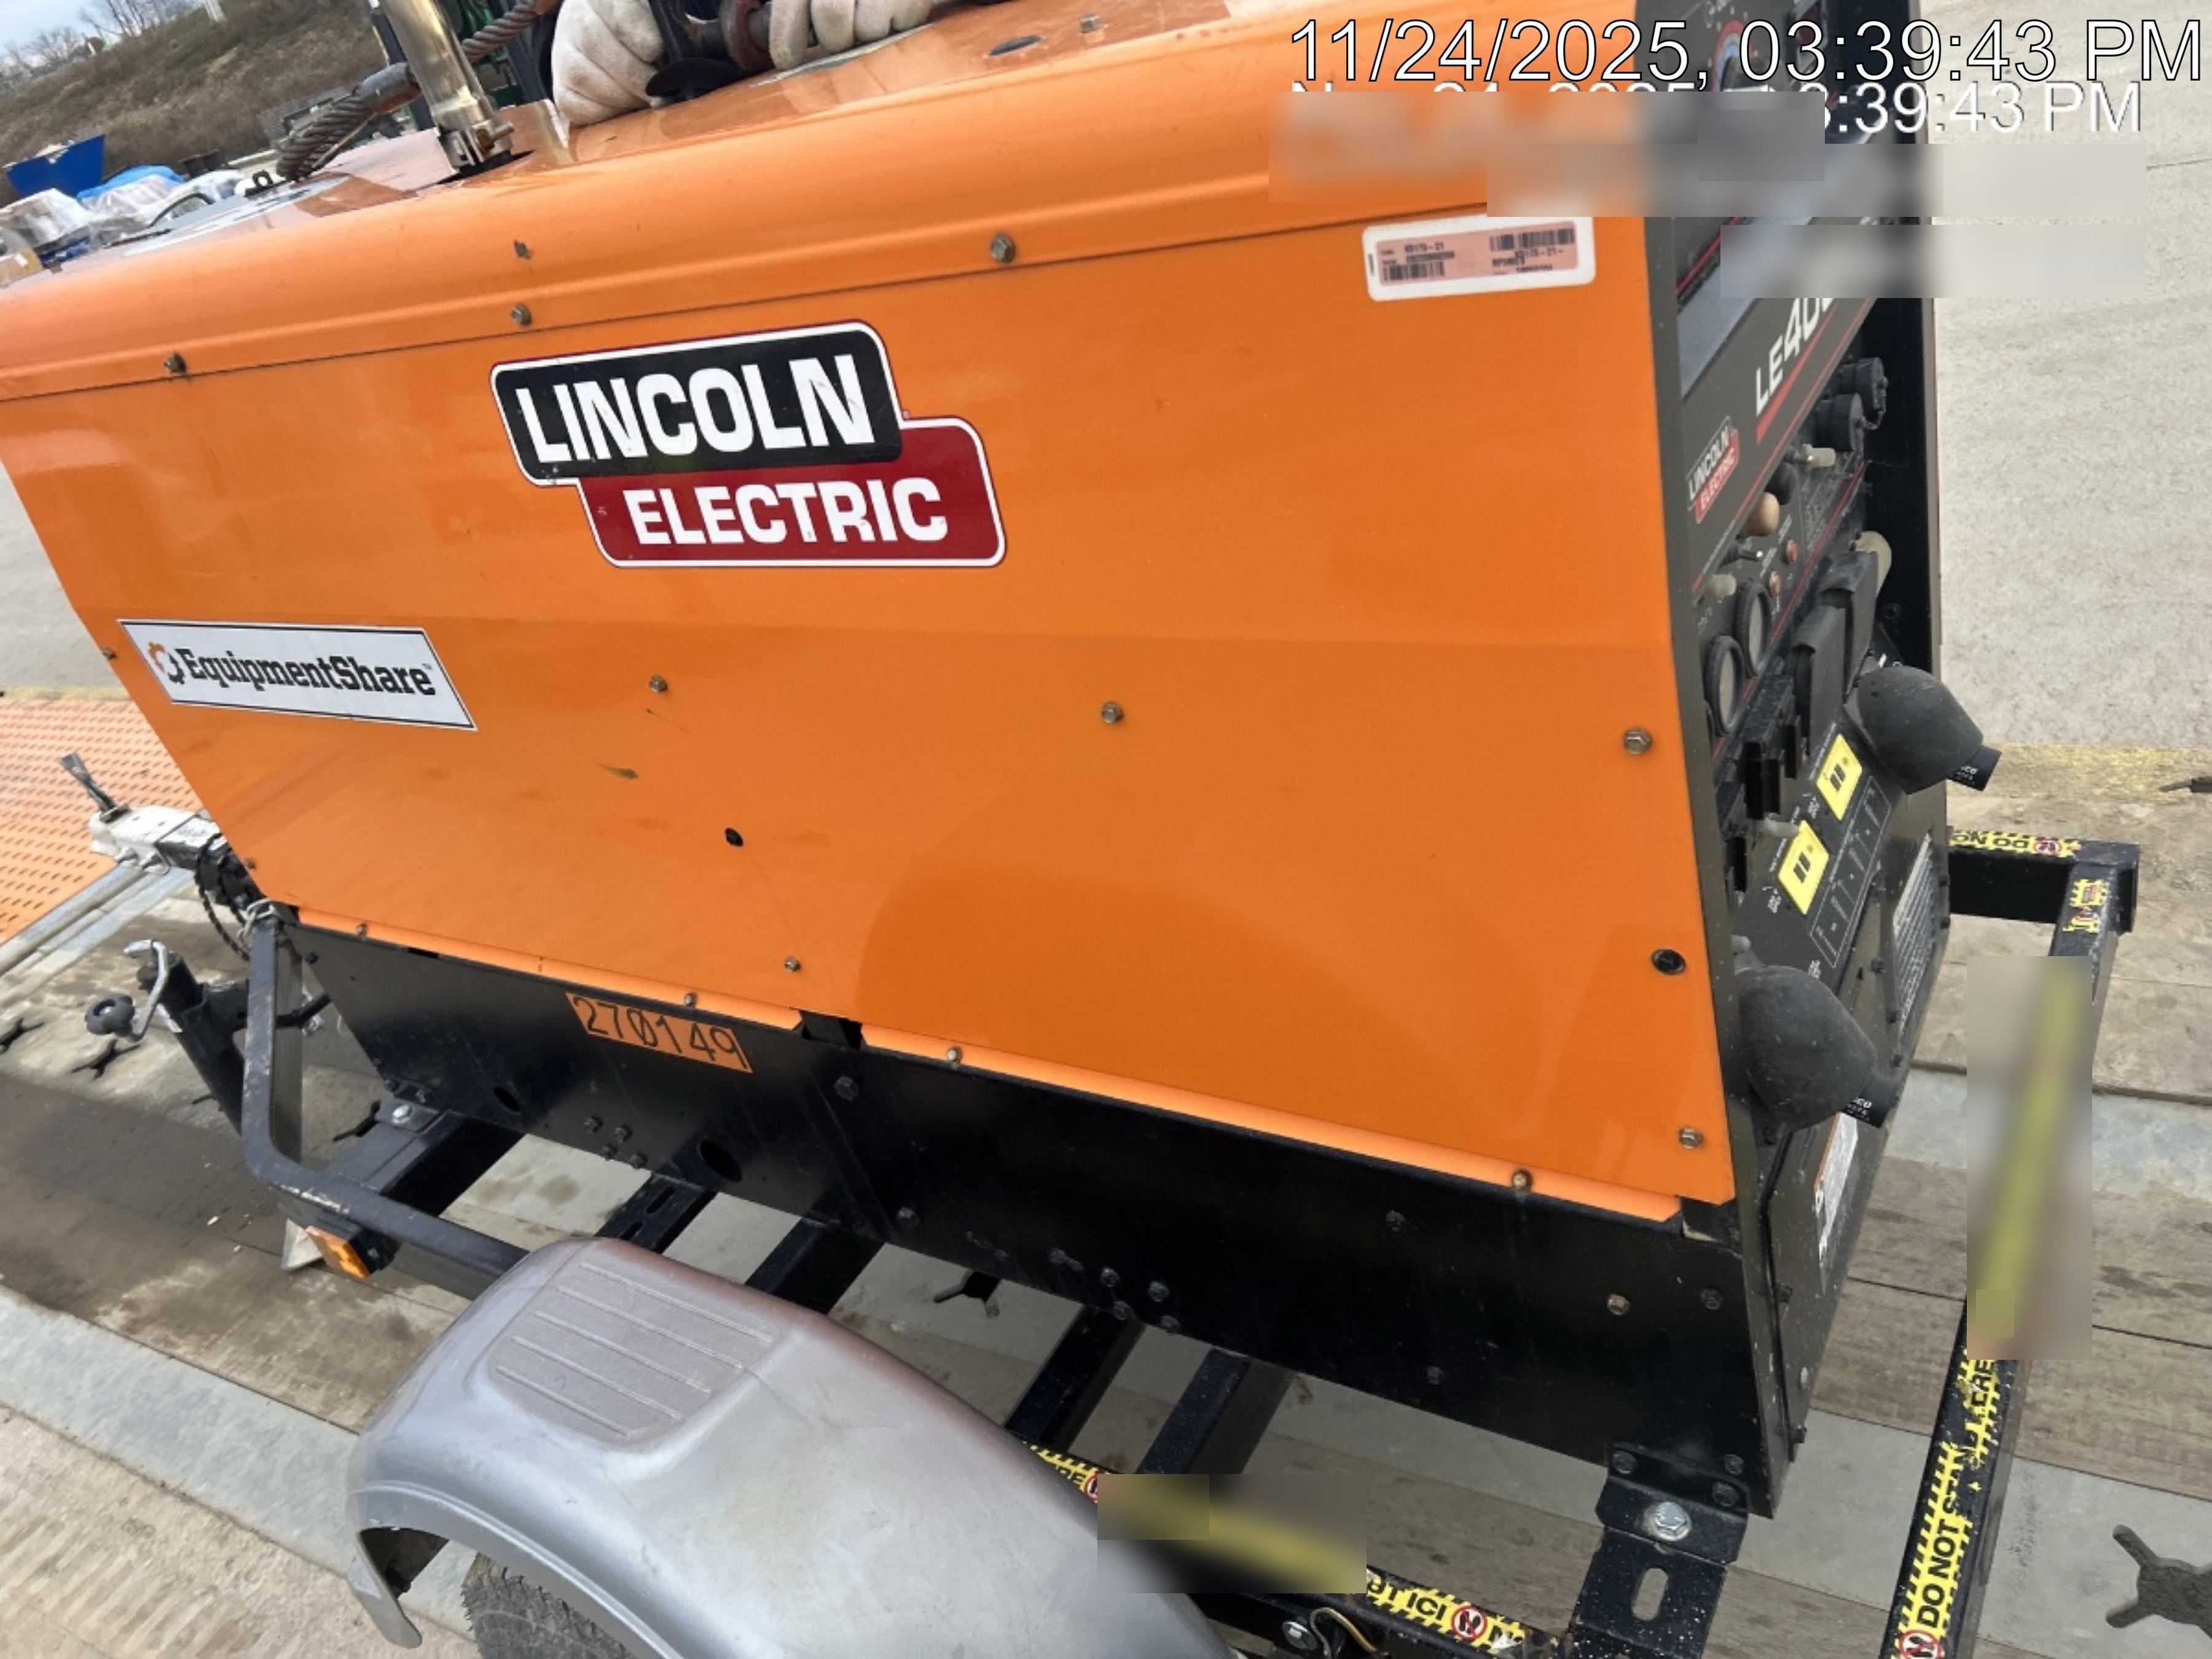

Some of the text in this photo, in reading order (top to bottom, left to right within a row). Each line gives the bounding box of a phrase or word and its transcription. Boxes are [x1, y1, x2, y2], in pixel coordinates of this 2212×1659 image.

[516, 353, 876, 463] LINCOLN
[622, 477, 949, 546] ELECTRIC
[175, 648, 436, 696] EquipmentShare
[573, 997, 750, 1070] 270149
[1929, 1519, 1960, 1580] NOT
[1406, 1592, 1448, 1620] ICI
[1918, 1580, 1945, 1629] DO
